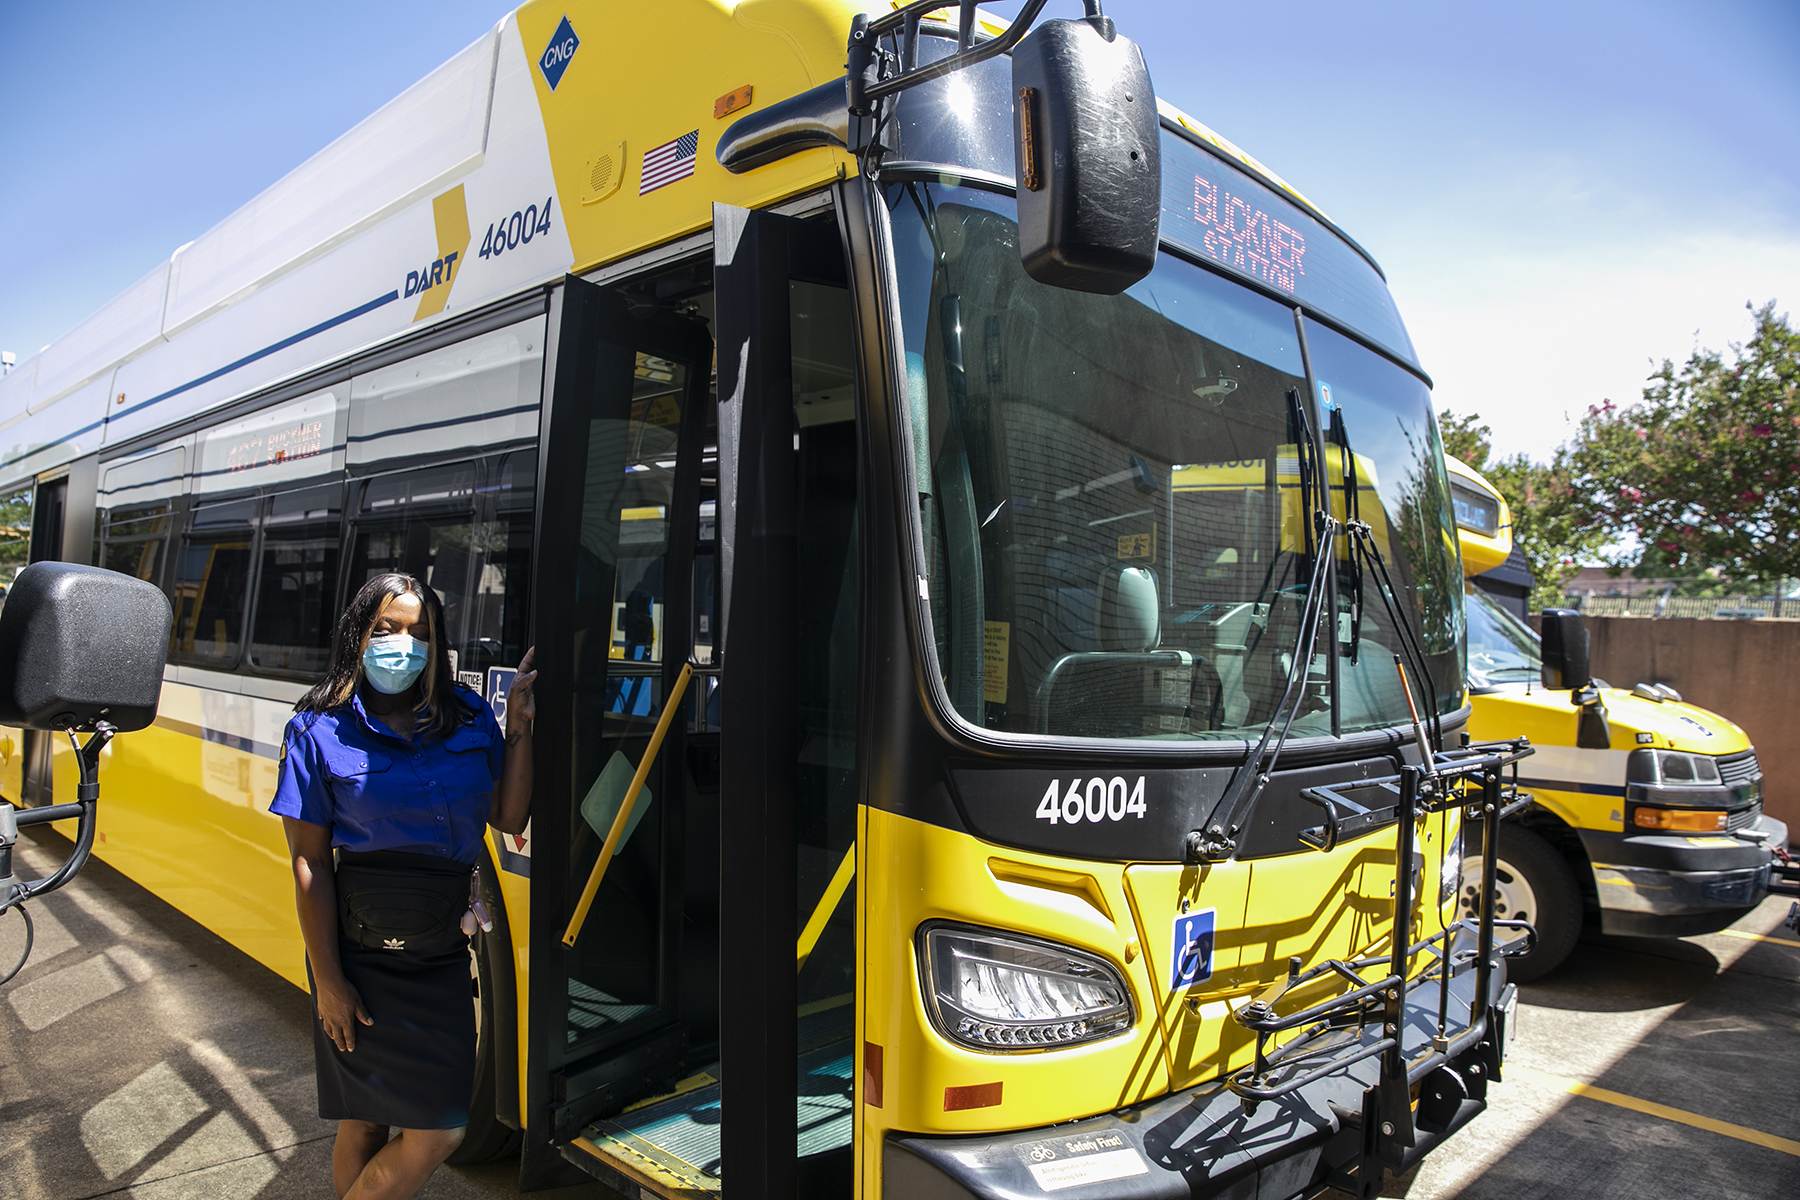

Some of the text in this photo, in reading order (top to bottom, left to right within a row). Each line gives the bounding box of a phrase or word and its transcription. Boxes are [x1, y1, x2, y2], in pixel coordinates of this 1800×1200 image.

[544, 37, 574, 69] CNG
[478, 196, 553, 261] 46004
[1194, 174, 1306, 276] BUCKNER
[403, 251, 459, 300] DART
[460, 673, 482, 685] NOTICE:
[1035, 775, 1147, 825] 46004
[1065, 1135, 1124, 1153] Safety First!
